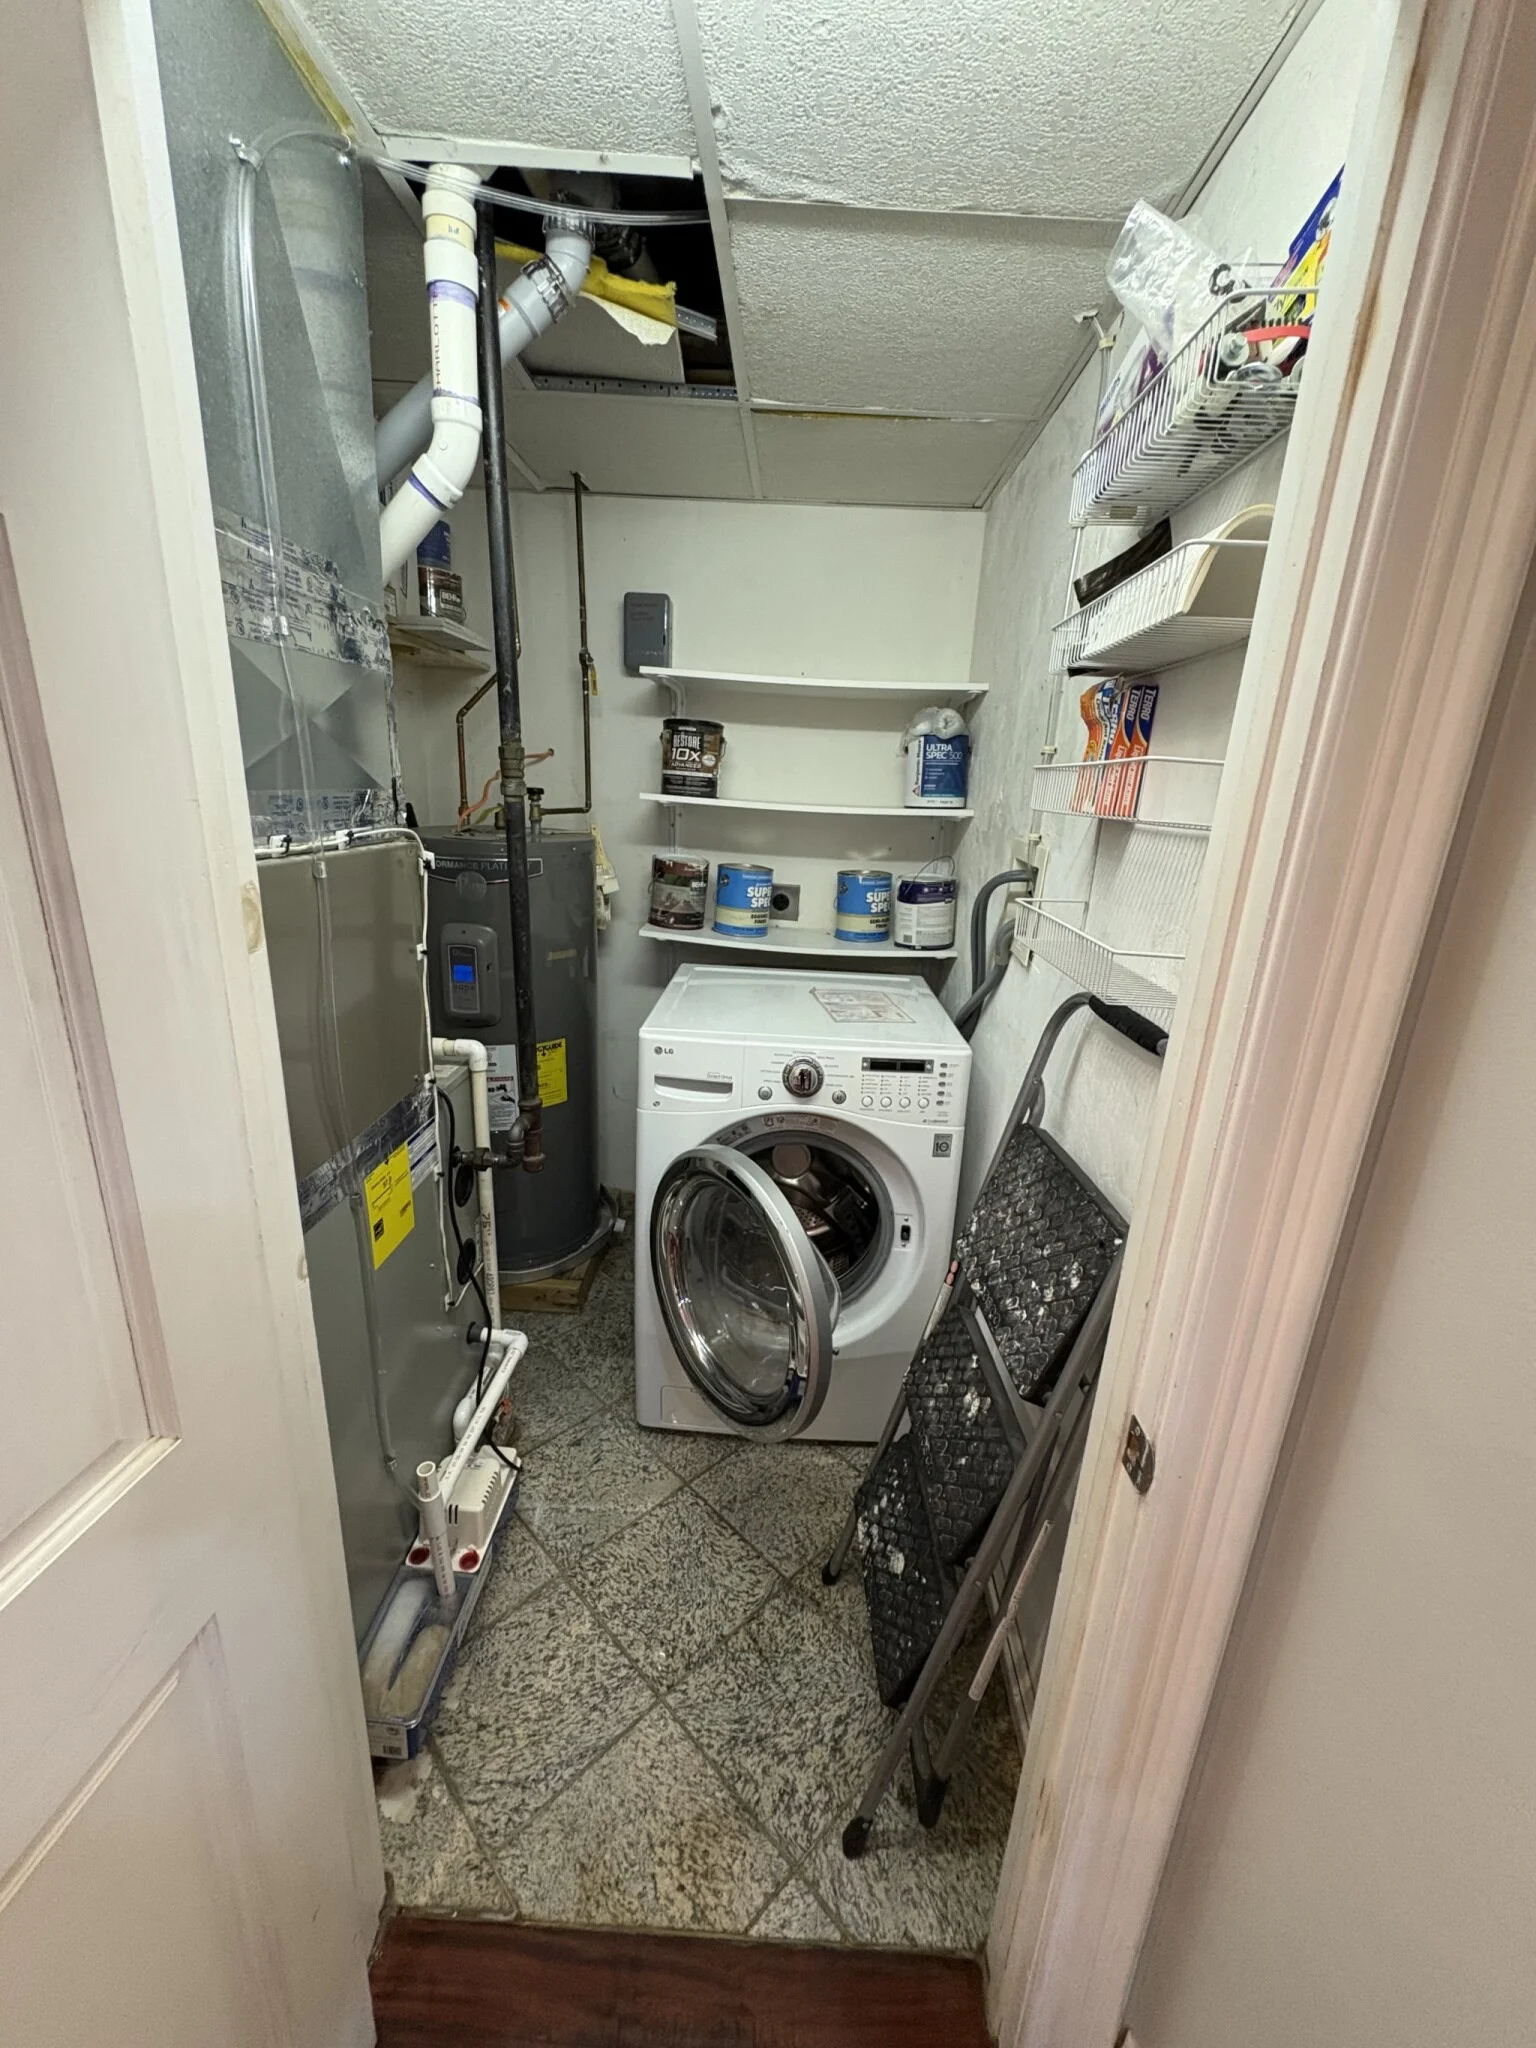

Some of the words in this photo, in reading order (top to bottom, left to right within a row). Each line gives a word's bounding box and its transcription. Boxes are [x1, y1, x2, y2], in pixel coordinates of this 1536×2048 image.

[1126, 689, 1140, 721] TERRO
[1140, 688, 1157, 721] TERRO
[673, 733, 702, 750] RESTORE
[925, 743, 953, 752] ULTRA
[925, 752, 947, 760] SPEC
[948, 752, 963, 760] 500
[671, 761, 702, 769] ADVANCED
[435, 861, 479, 869] ORMANCE
